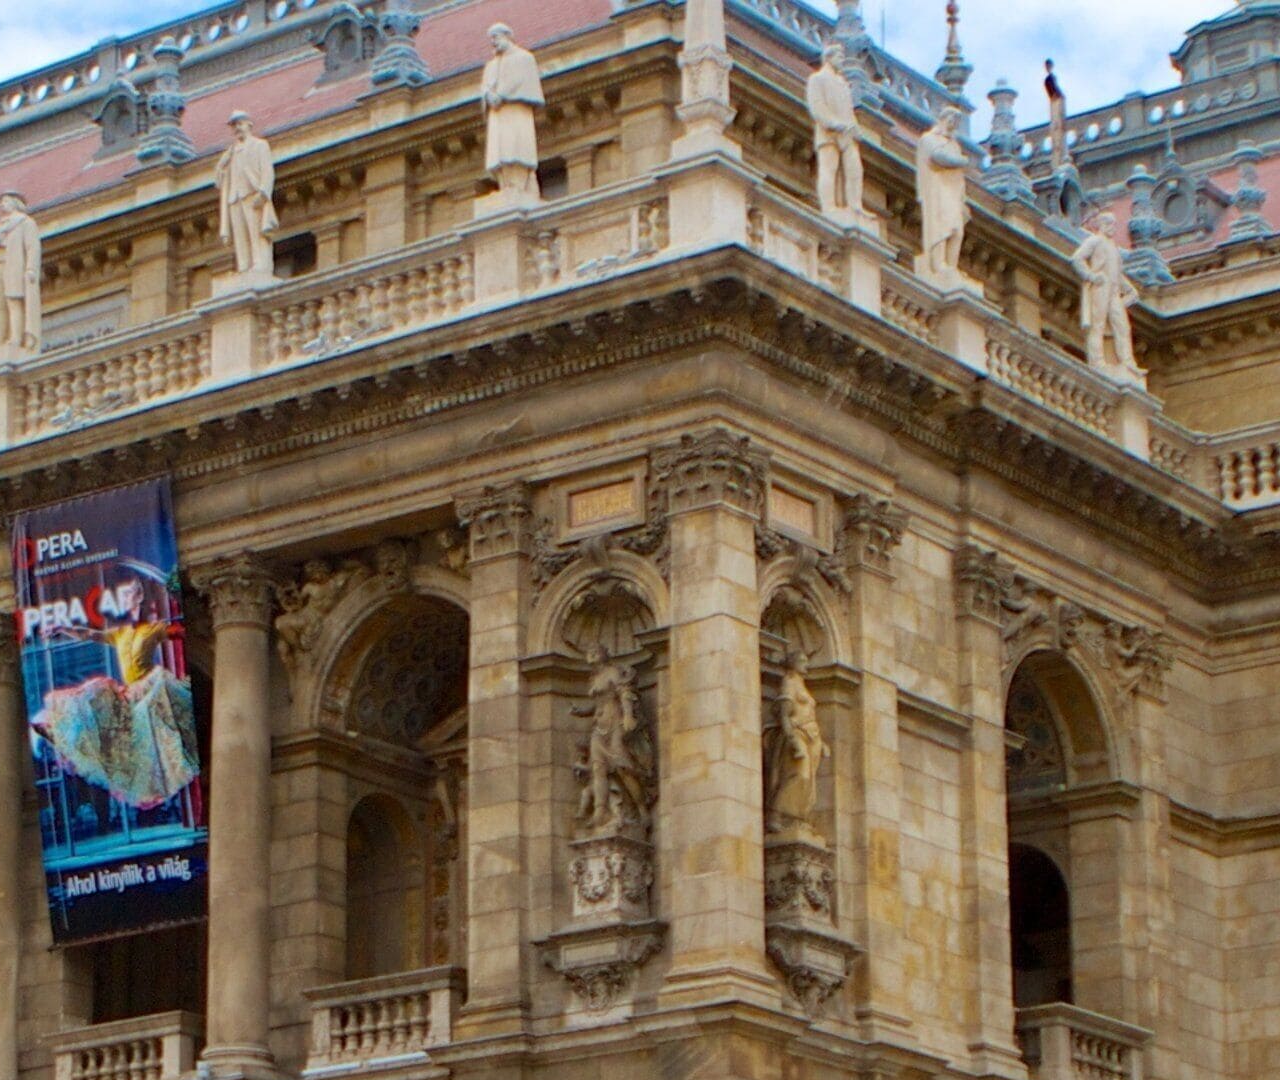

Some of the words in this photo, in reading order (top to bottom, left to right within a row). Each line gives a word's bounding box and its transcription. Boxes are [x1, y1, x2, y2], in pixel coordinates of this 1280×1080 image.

[66, 872, 97, 898] Ahol
[146, 864, 157, 882] a
[158, 855, 192, 881] világ
